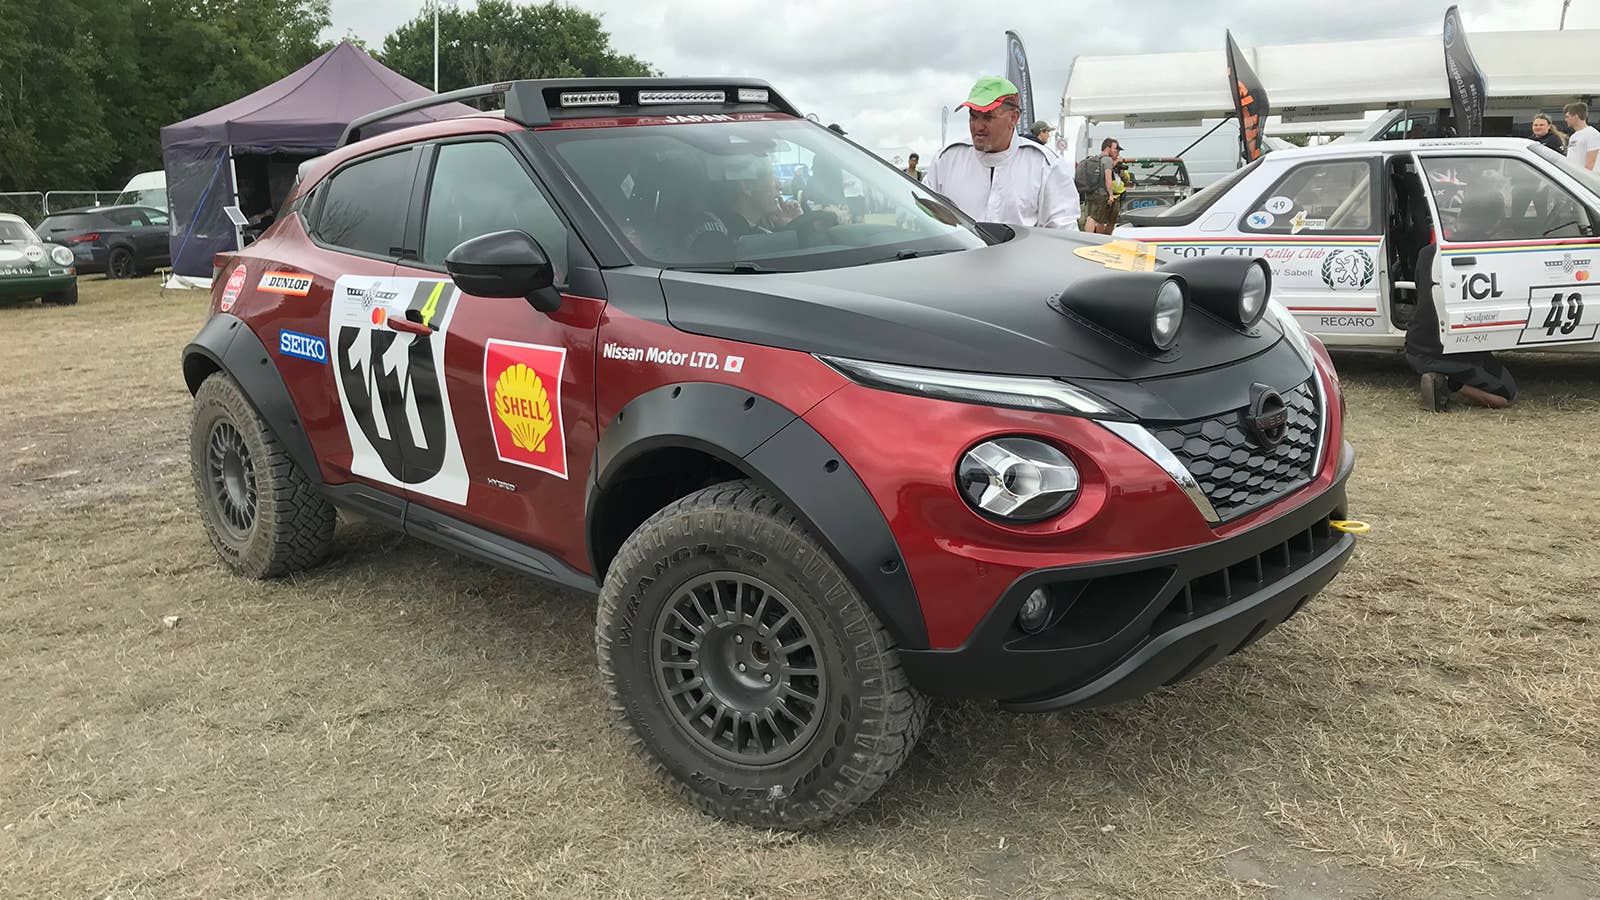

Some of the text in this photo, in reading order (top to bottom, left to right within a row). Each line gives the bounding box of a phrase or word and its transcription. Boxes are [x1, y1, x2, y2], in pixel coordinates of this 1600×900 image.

[665, 114, 735, 123] JAPAN
[1272, 201, 1286, 210] 49
[1263, 248, 1295, 263] Rally
[1298, 248, 1326, 259] Club
[1284, 268, 1313, 277] Sabelt
[268, 276, 309, 290] DUNLOP
[1461, 272, 1504, 300] ICL
[1320, 316, 1375, 327] RECARO
[1464, 312, 1498, 324] Sculptor
[1543, 292, 1584, 336] 49
[280, 332, 326, 360] SEIKO
[603, 342, 720, 370] Nissan Motor LTD.
[502, 394, 545, 422] SHELL
[619, 543, 768, 647] WRANGLER
